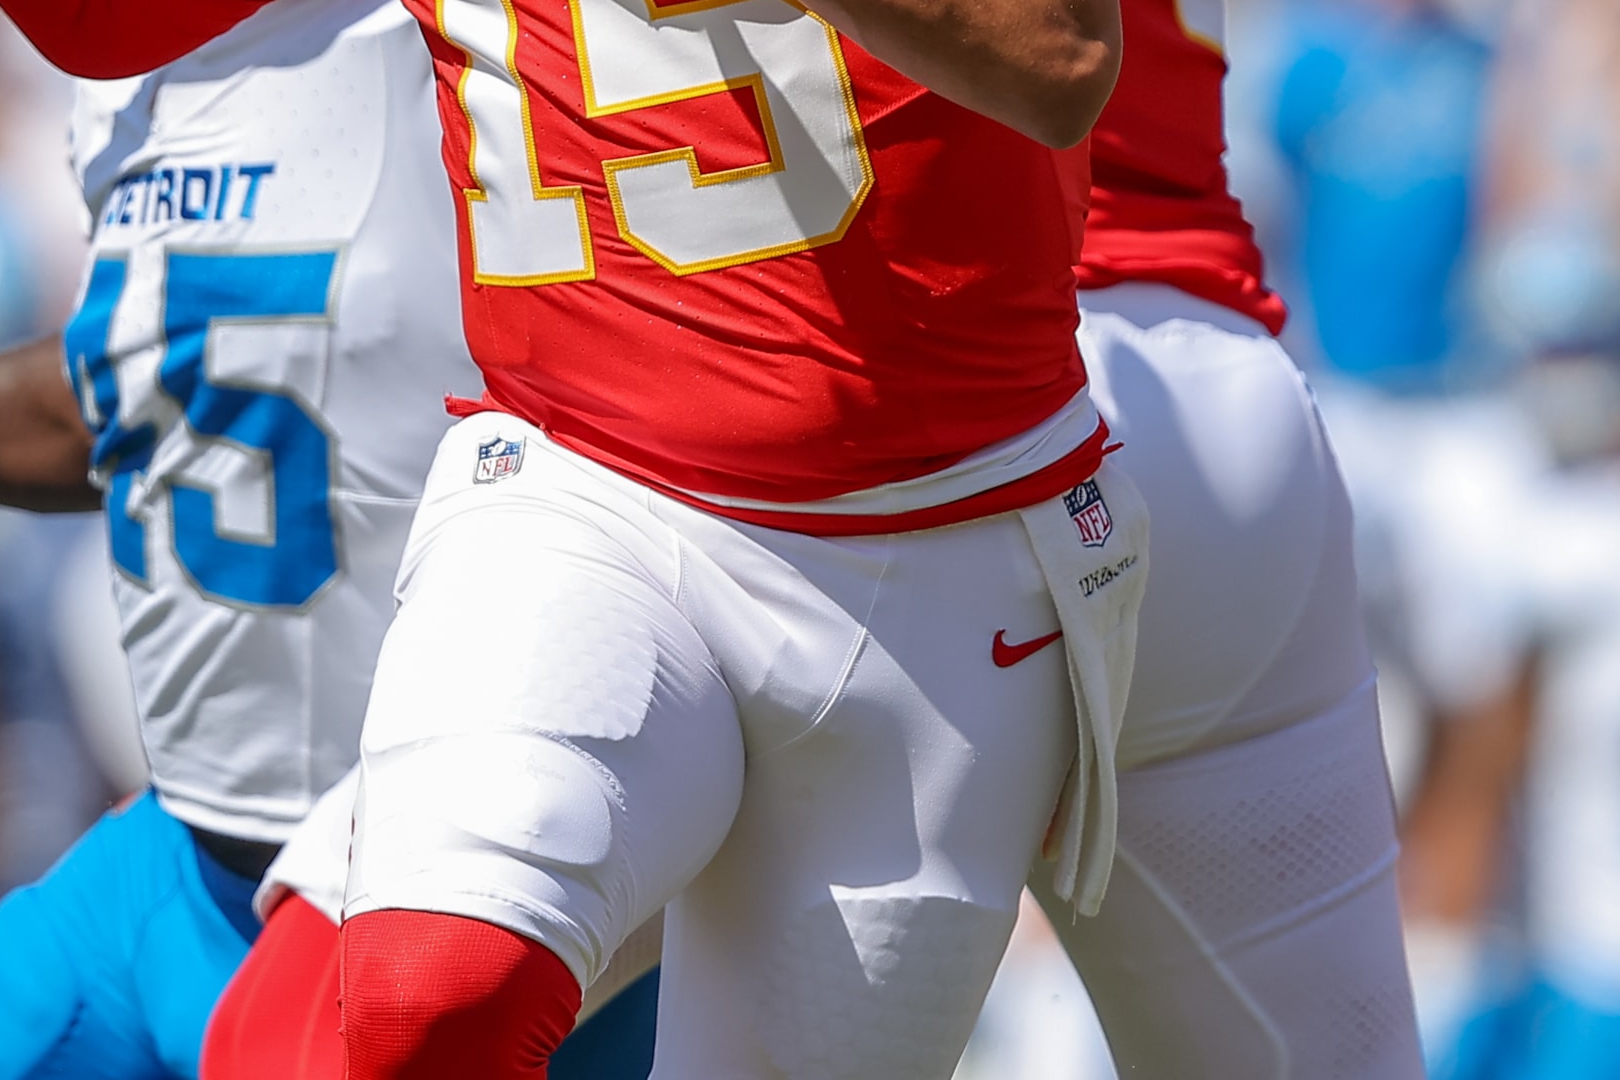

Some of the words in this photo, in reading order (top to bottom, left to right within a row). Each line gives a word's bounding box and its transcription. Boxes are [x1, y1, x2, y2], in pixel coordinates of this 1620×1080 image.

[481, 456, 514, 478] NFL
[1073, 502, 1111, 543] NFL
[1078, 554, 1139, 599] Wilson
